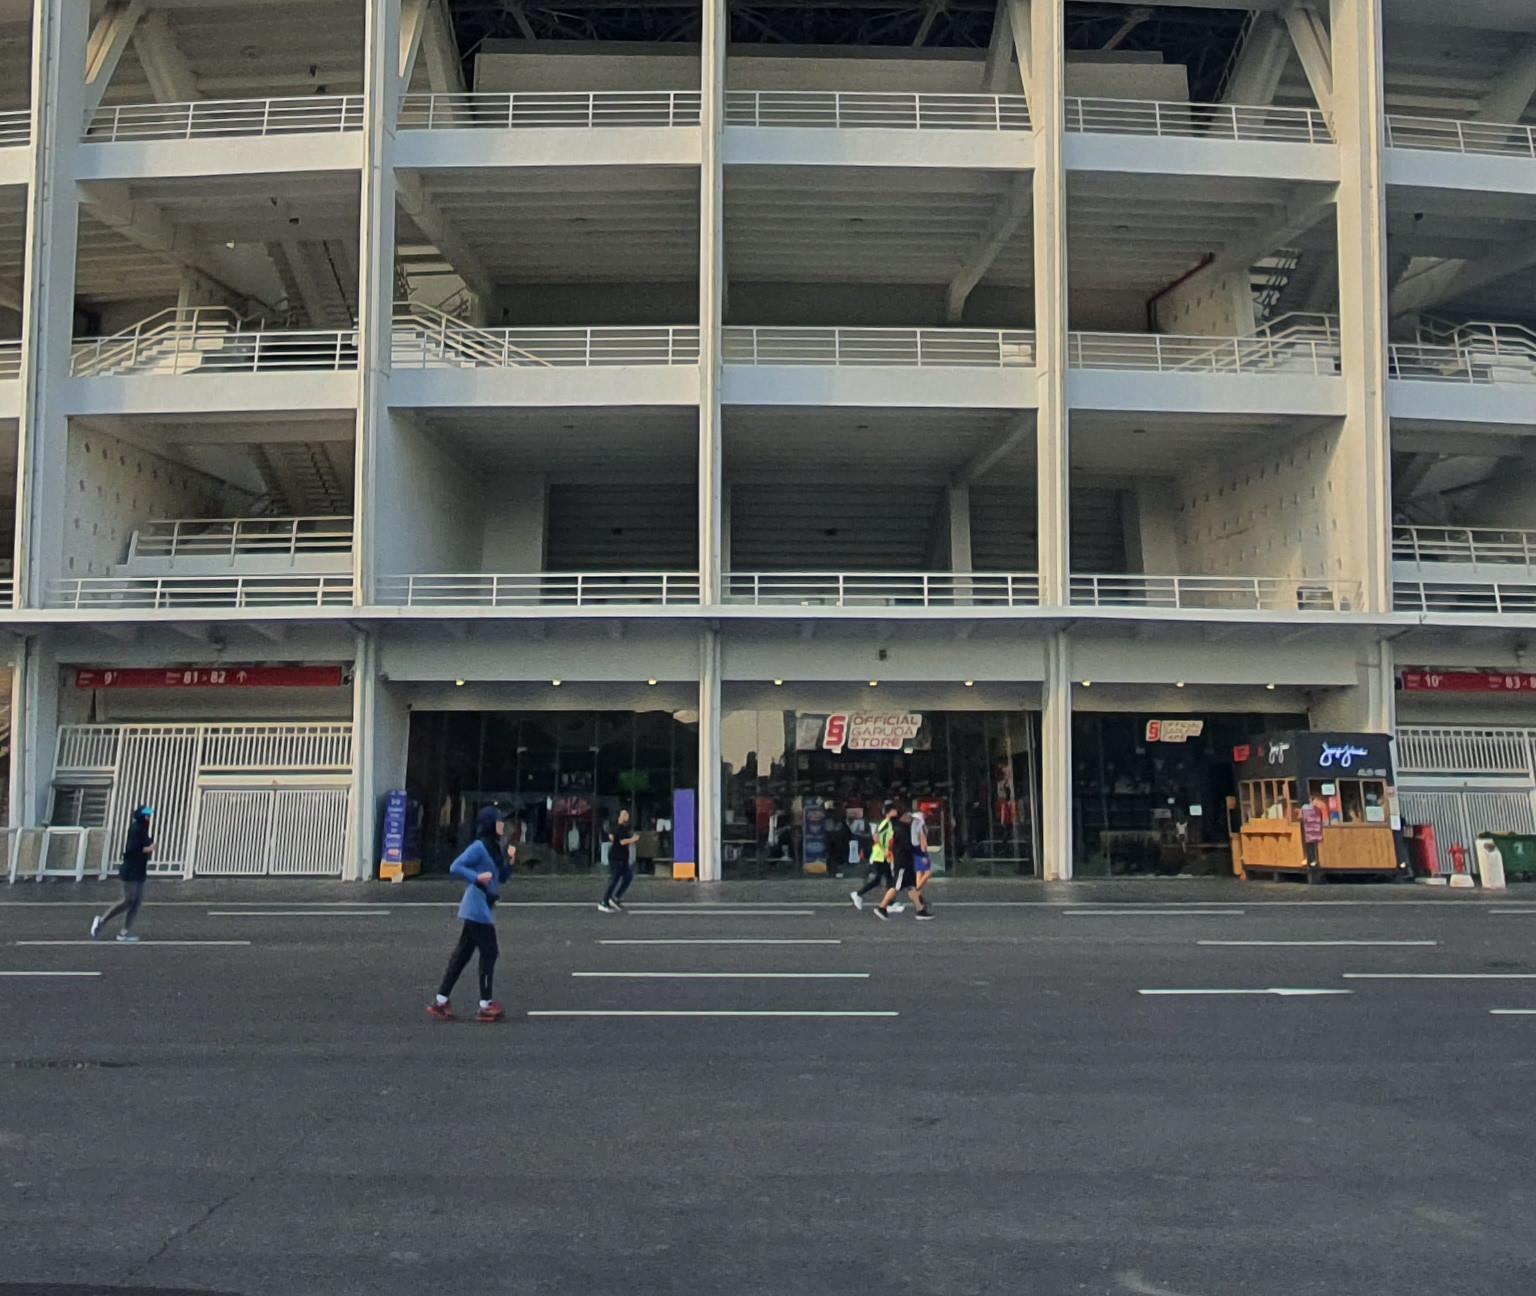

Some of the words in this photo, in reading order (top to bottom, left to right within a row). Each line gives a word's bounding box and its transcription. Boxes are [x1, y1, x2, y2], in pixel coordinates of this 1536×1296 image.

[853, 714, 918, 726] OFFICIAL
[851, 726, 914, 737] GARUDA
[850, 737, 900, 748] STORE
